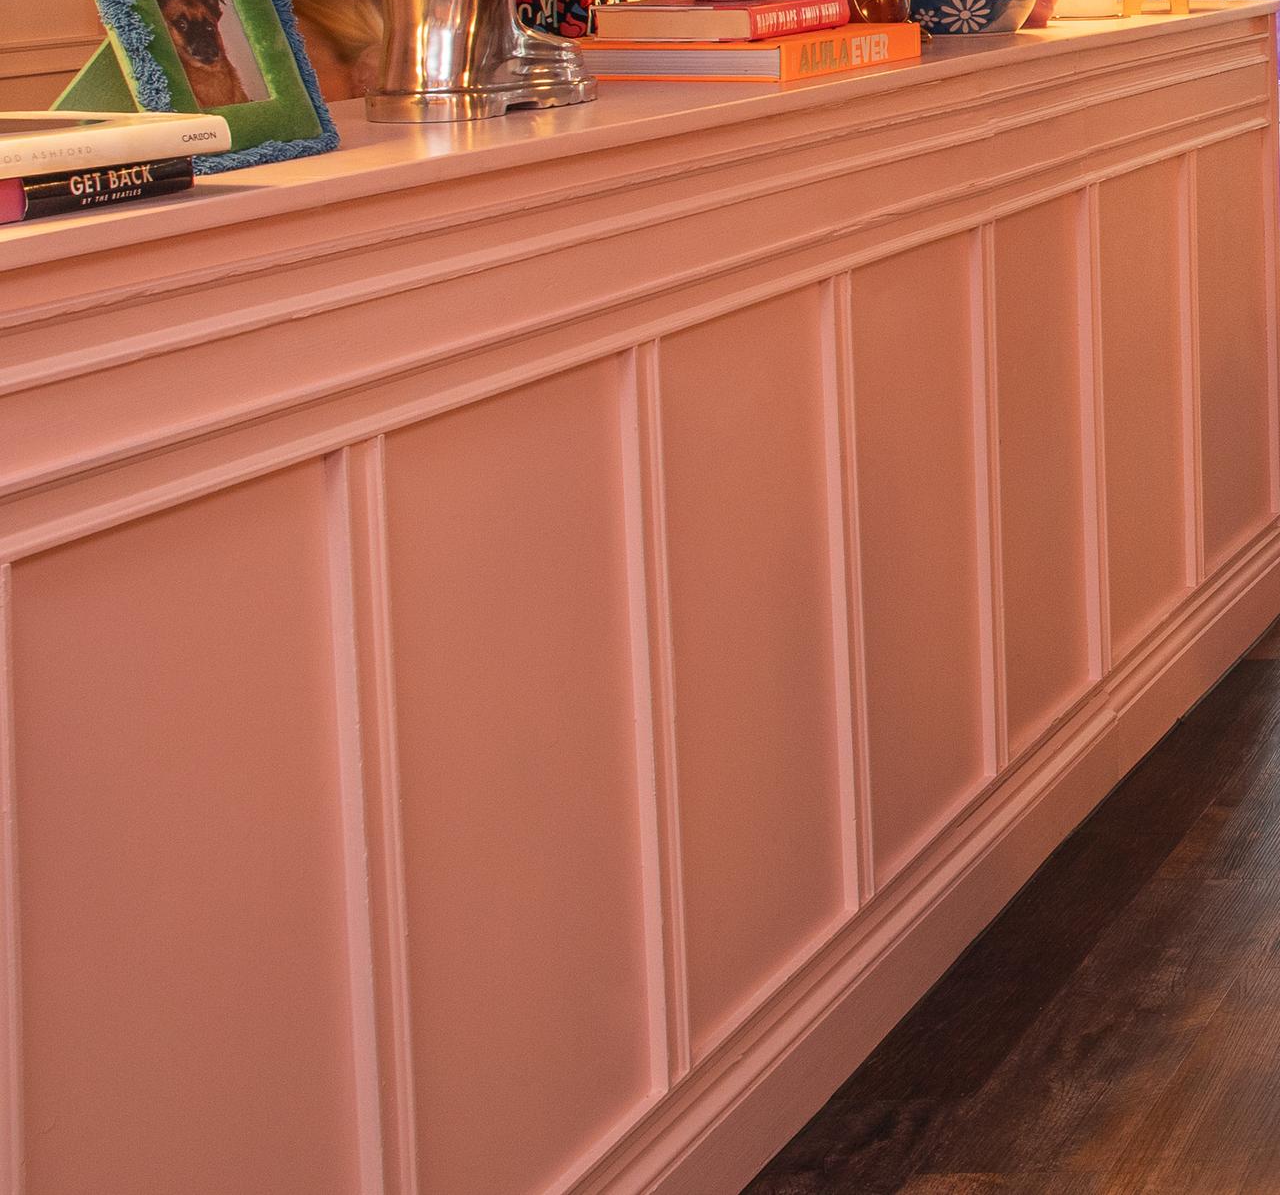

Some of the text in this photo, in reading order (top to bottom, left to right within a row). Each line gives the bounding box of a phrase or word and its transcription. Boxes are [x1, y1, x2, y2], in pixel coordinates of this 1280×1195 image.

[756, 2, 840, 35] HAPPY PLACE EMILY HENRY
[850, 33, 889, 66] EVER
[0, 145, 93, 165] OD ASHFORD
[69, 163, 153, 196] GET BACK
[81, 188, 142, 205] BY THE BEATLES
